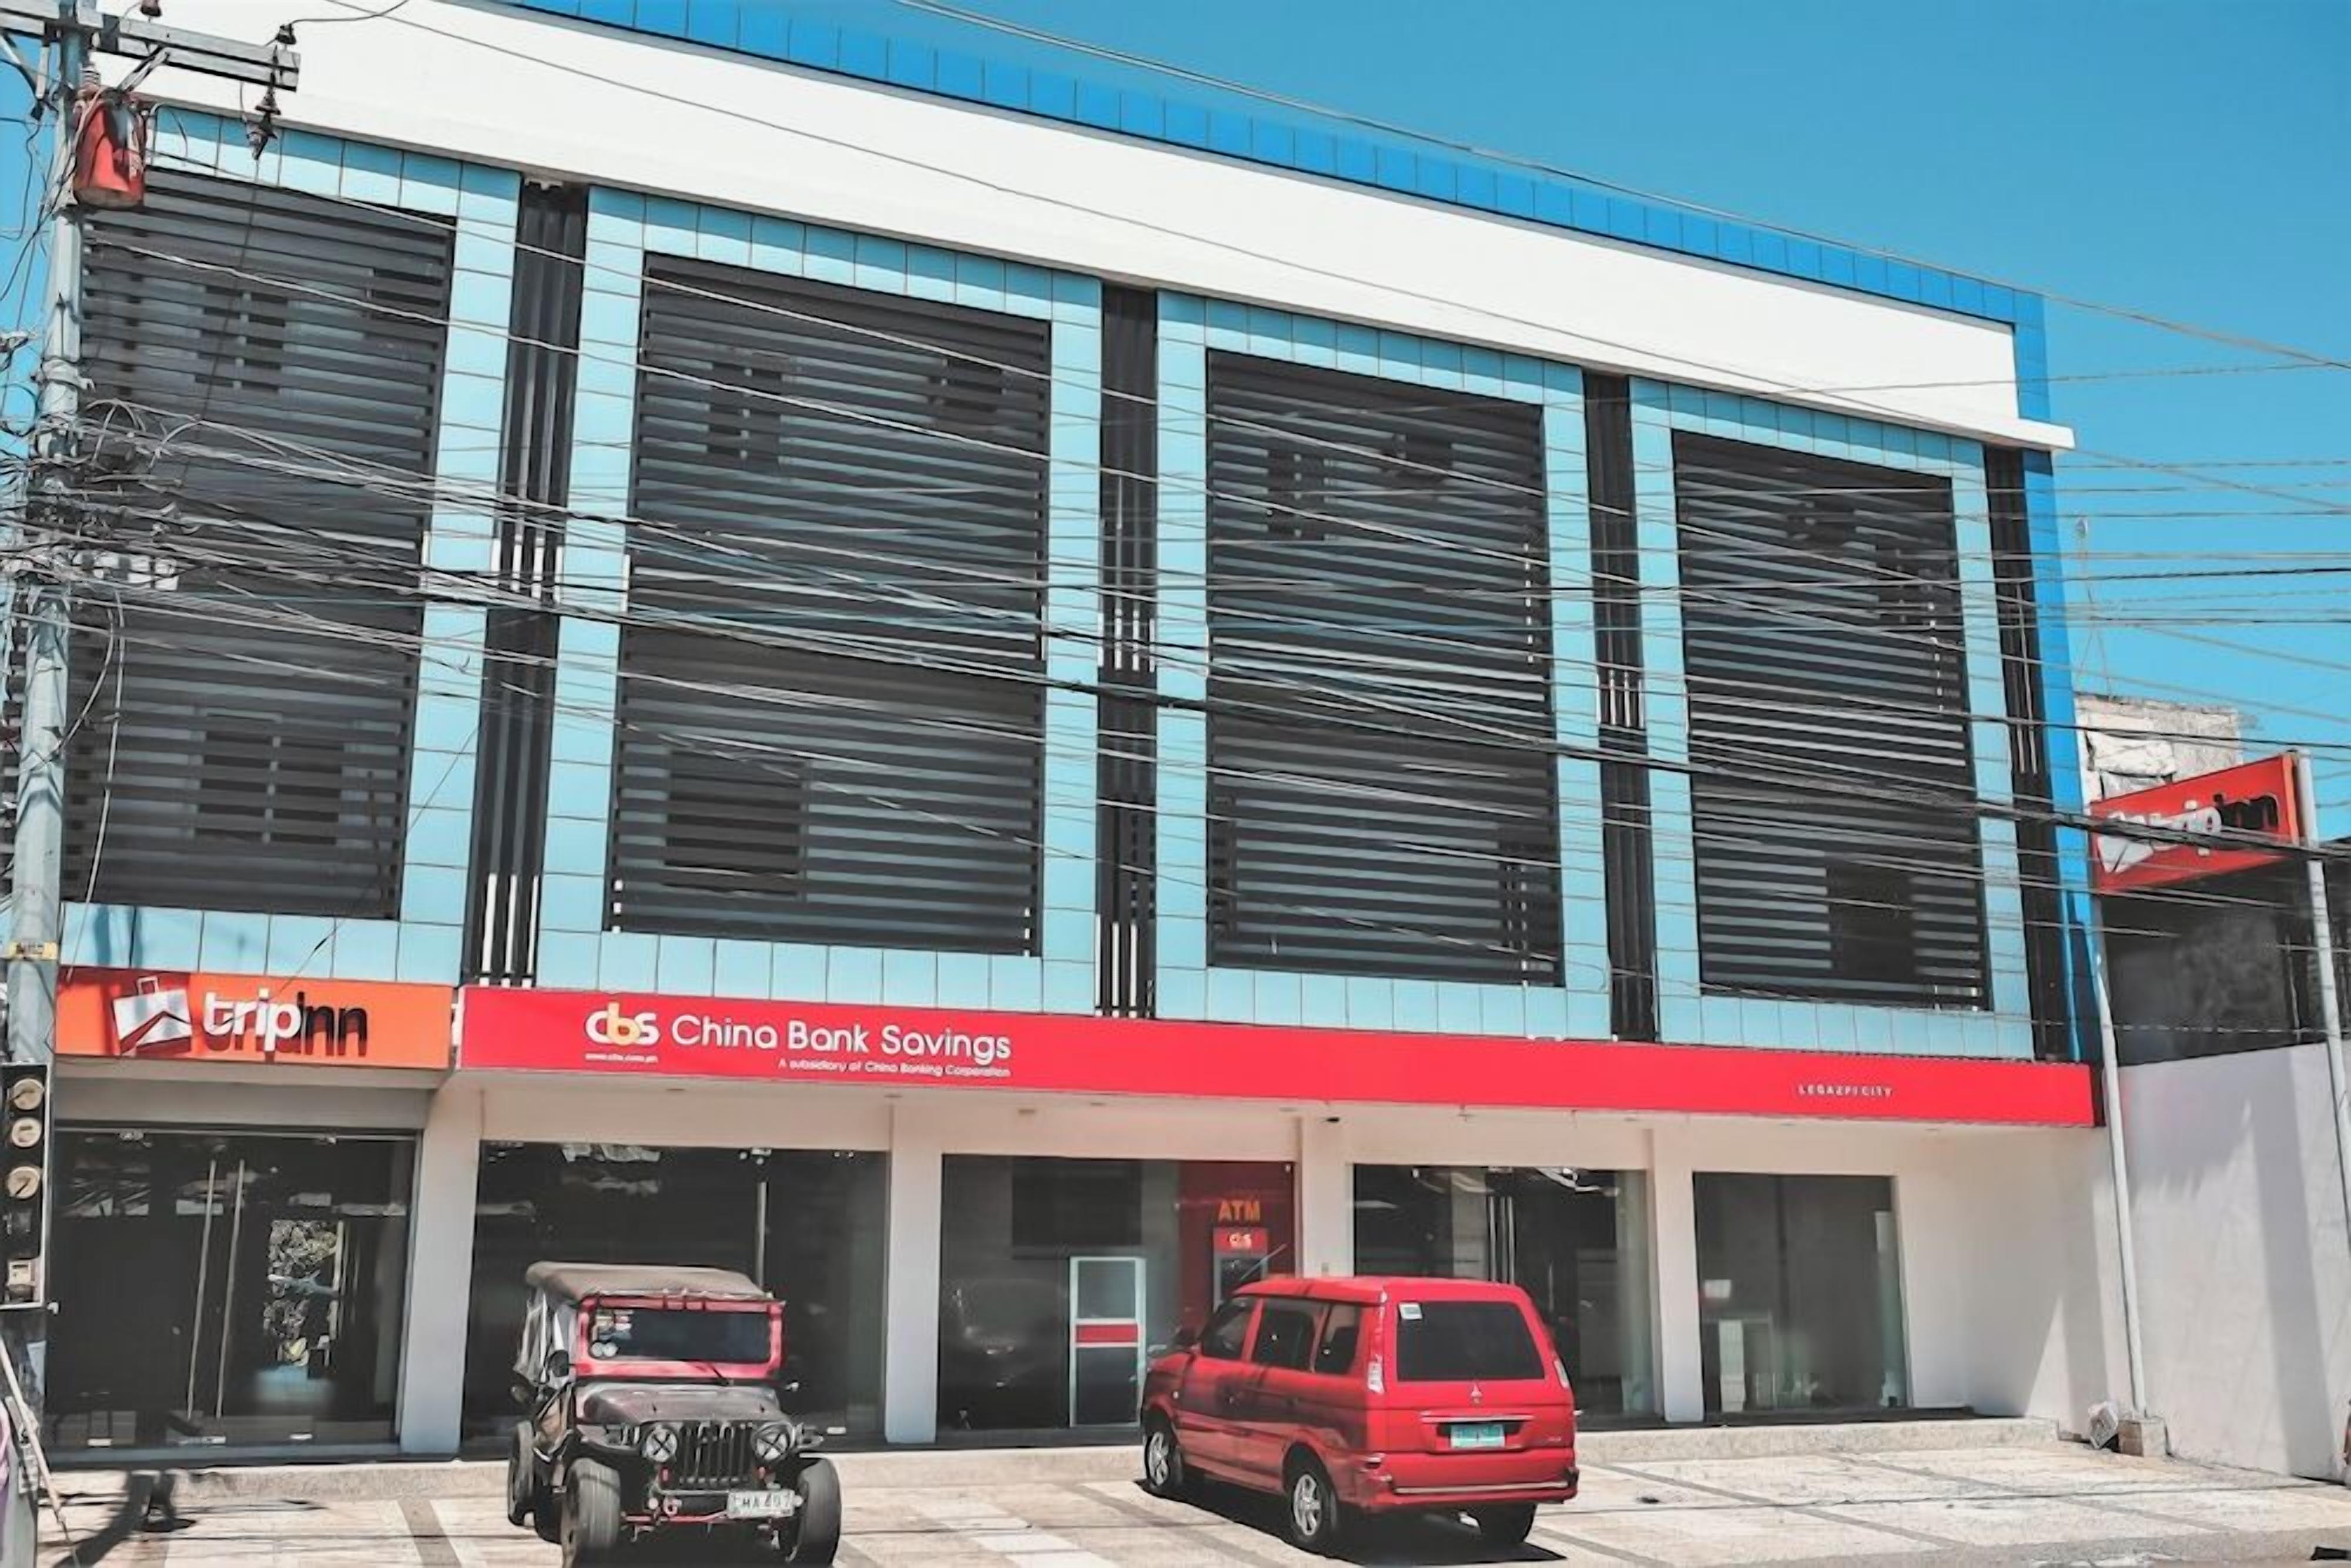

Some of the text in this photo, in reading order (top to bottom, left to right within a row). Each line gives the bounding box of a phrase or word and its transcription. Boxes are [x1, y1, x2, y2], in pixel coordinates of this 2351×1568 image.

[586, 1003, 659, 1046] cbs
[672, 1014, 1011, 1066] China Bank Savings
[778, 1058, 787, 1068] A
[1218, 1200, 1260, 1221] ATM
